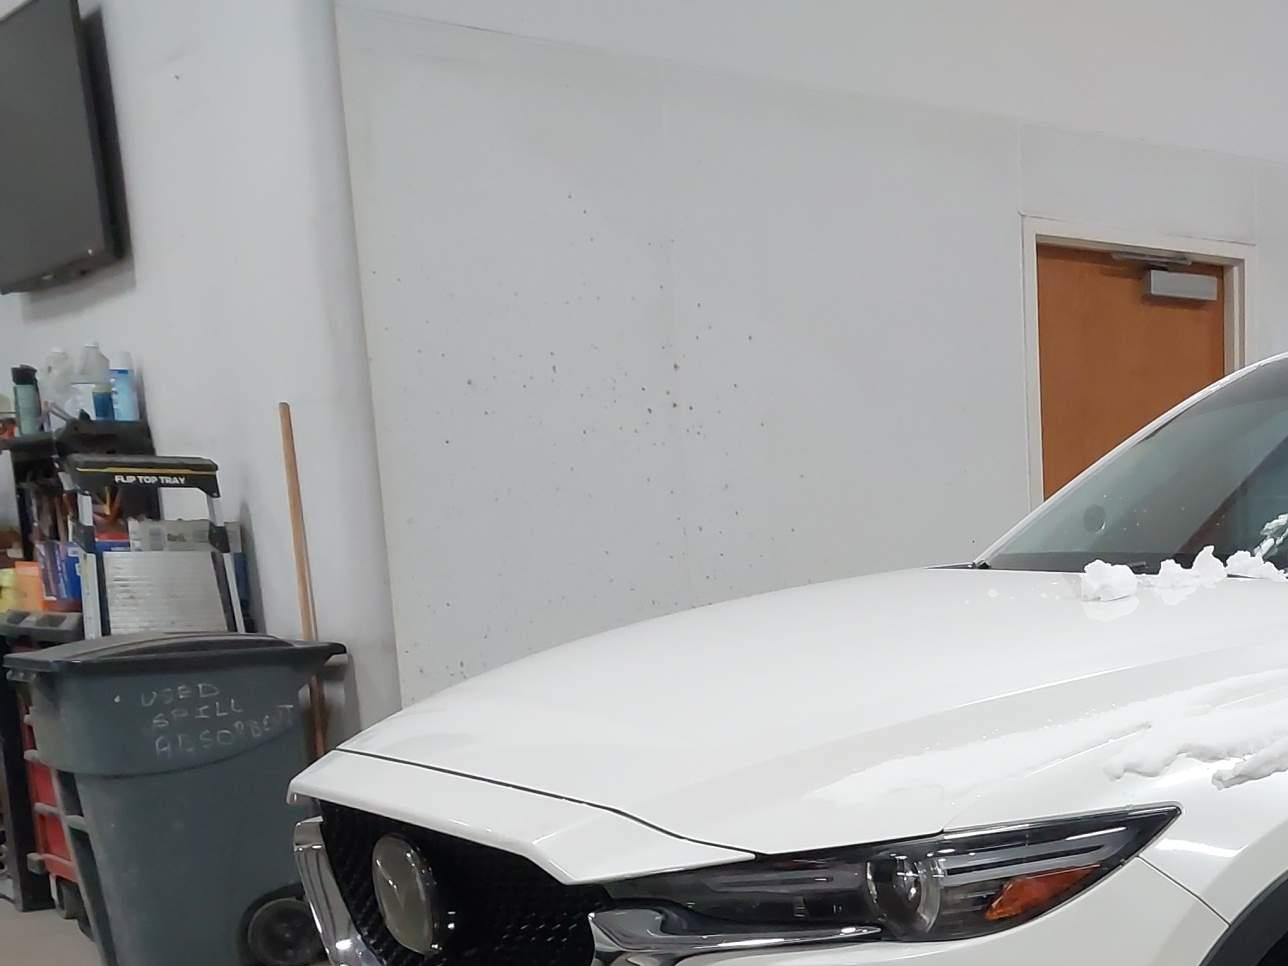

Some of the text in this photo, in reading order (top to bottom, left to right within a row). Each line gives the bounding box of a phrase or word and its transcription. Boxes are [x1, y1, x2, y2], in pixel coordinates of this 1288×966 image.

[114, 475, 186, 485] FLIP TOP TRAY
[141, 683, 221, 707] USED
[152, 698, 243, 728] SPILL
